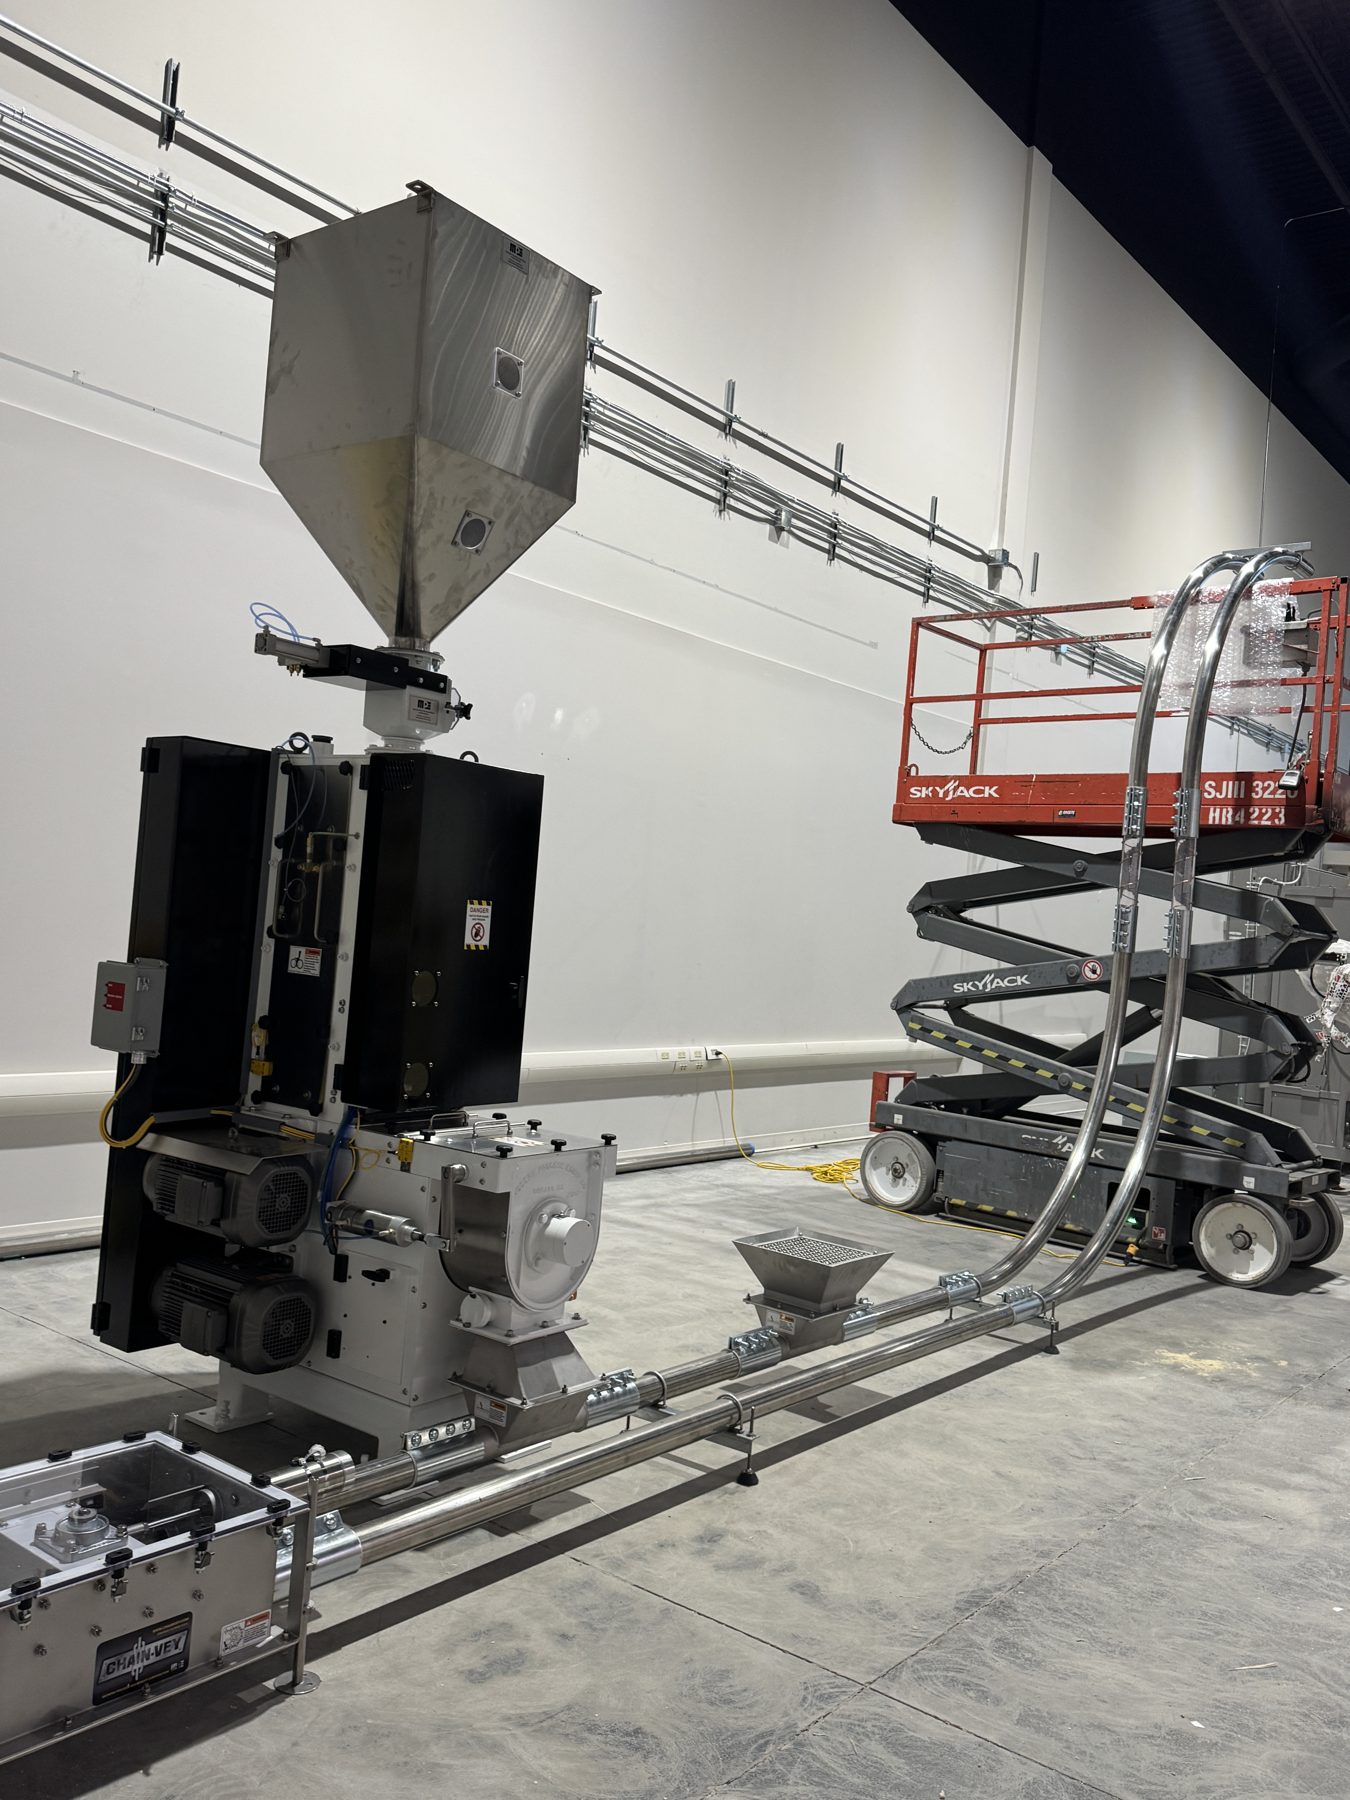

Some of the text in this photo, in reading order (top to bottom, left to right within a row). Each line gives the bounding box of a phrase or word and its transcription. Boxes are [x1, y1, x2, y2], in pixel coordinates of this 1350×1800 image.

[909, 779, 1000, 801] SKYJACK
[1203, 780, 1245, 799] SJIII
[470, 906, 489, 914] DANGER
[953, 973, 1031, 993] SKYJACK
[105, 1636, 183, 1676] CHAIN-VEY
